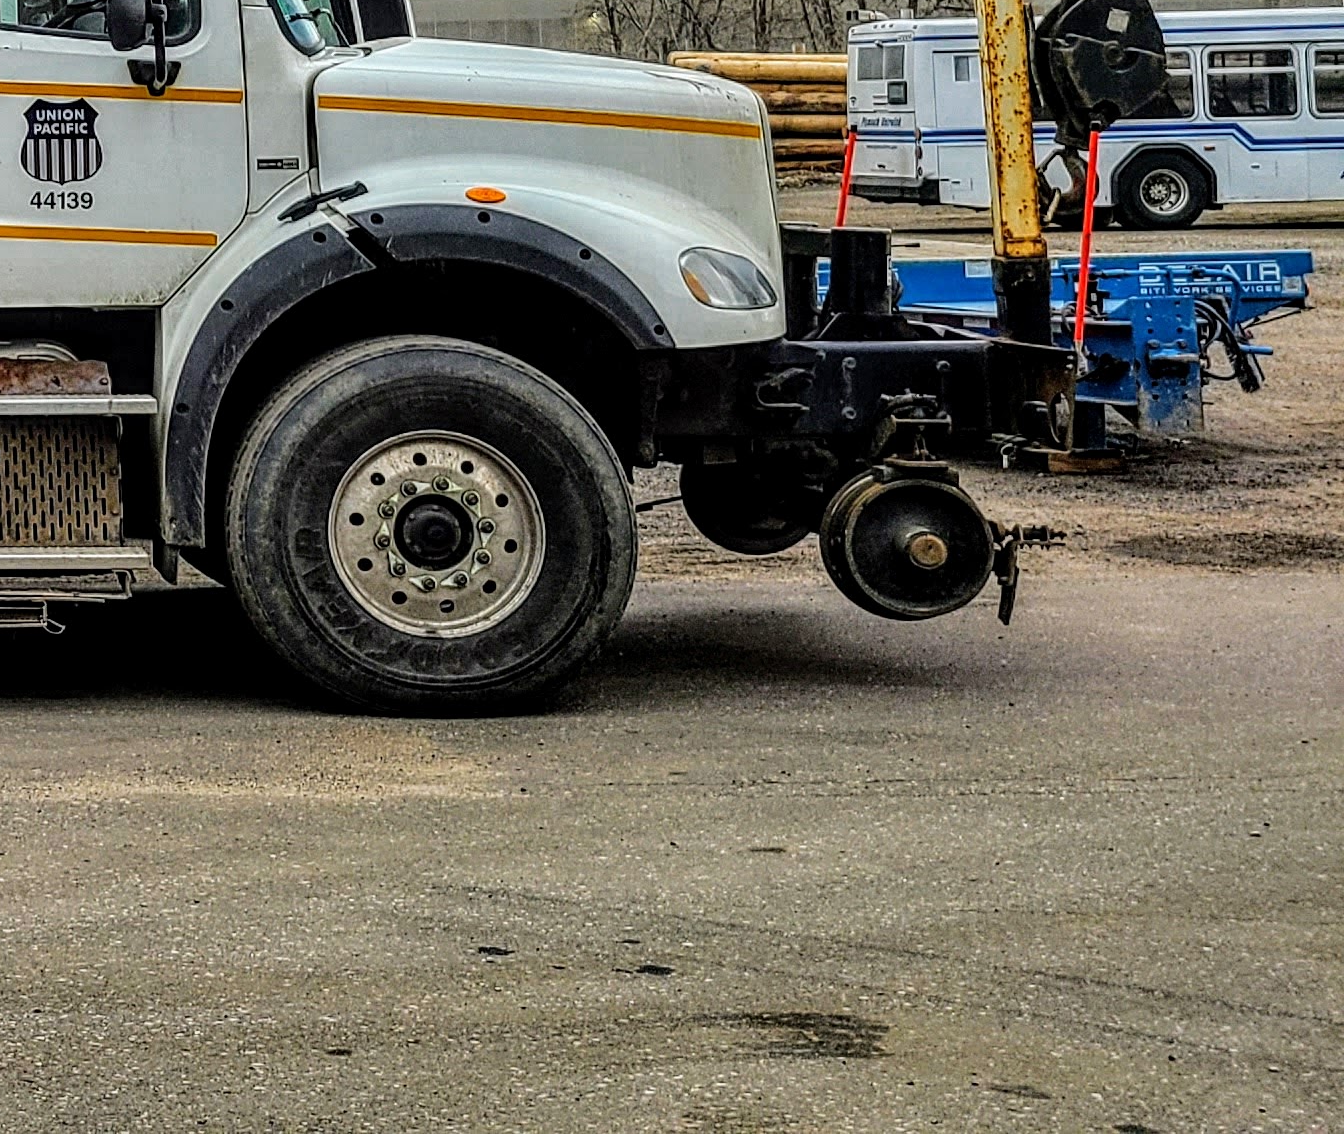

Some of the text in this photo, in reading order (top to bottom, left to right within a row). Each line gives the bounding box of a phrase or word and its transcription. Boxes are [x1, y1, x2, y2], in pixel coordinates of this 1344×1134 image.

[35, 108, 85, 122] UNION
[33, 122, 88, 135] PACIFIC
[29, 190, 94, 210] 44139
